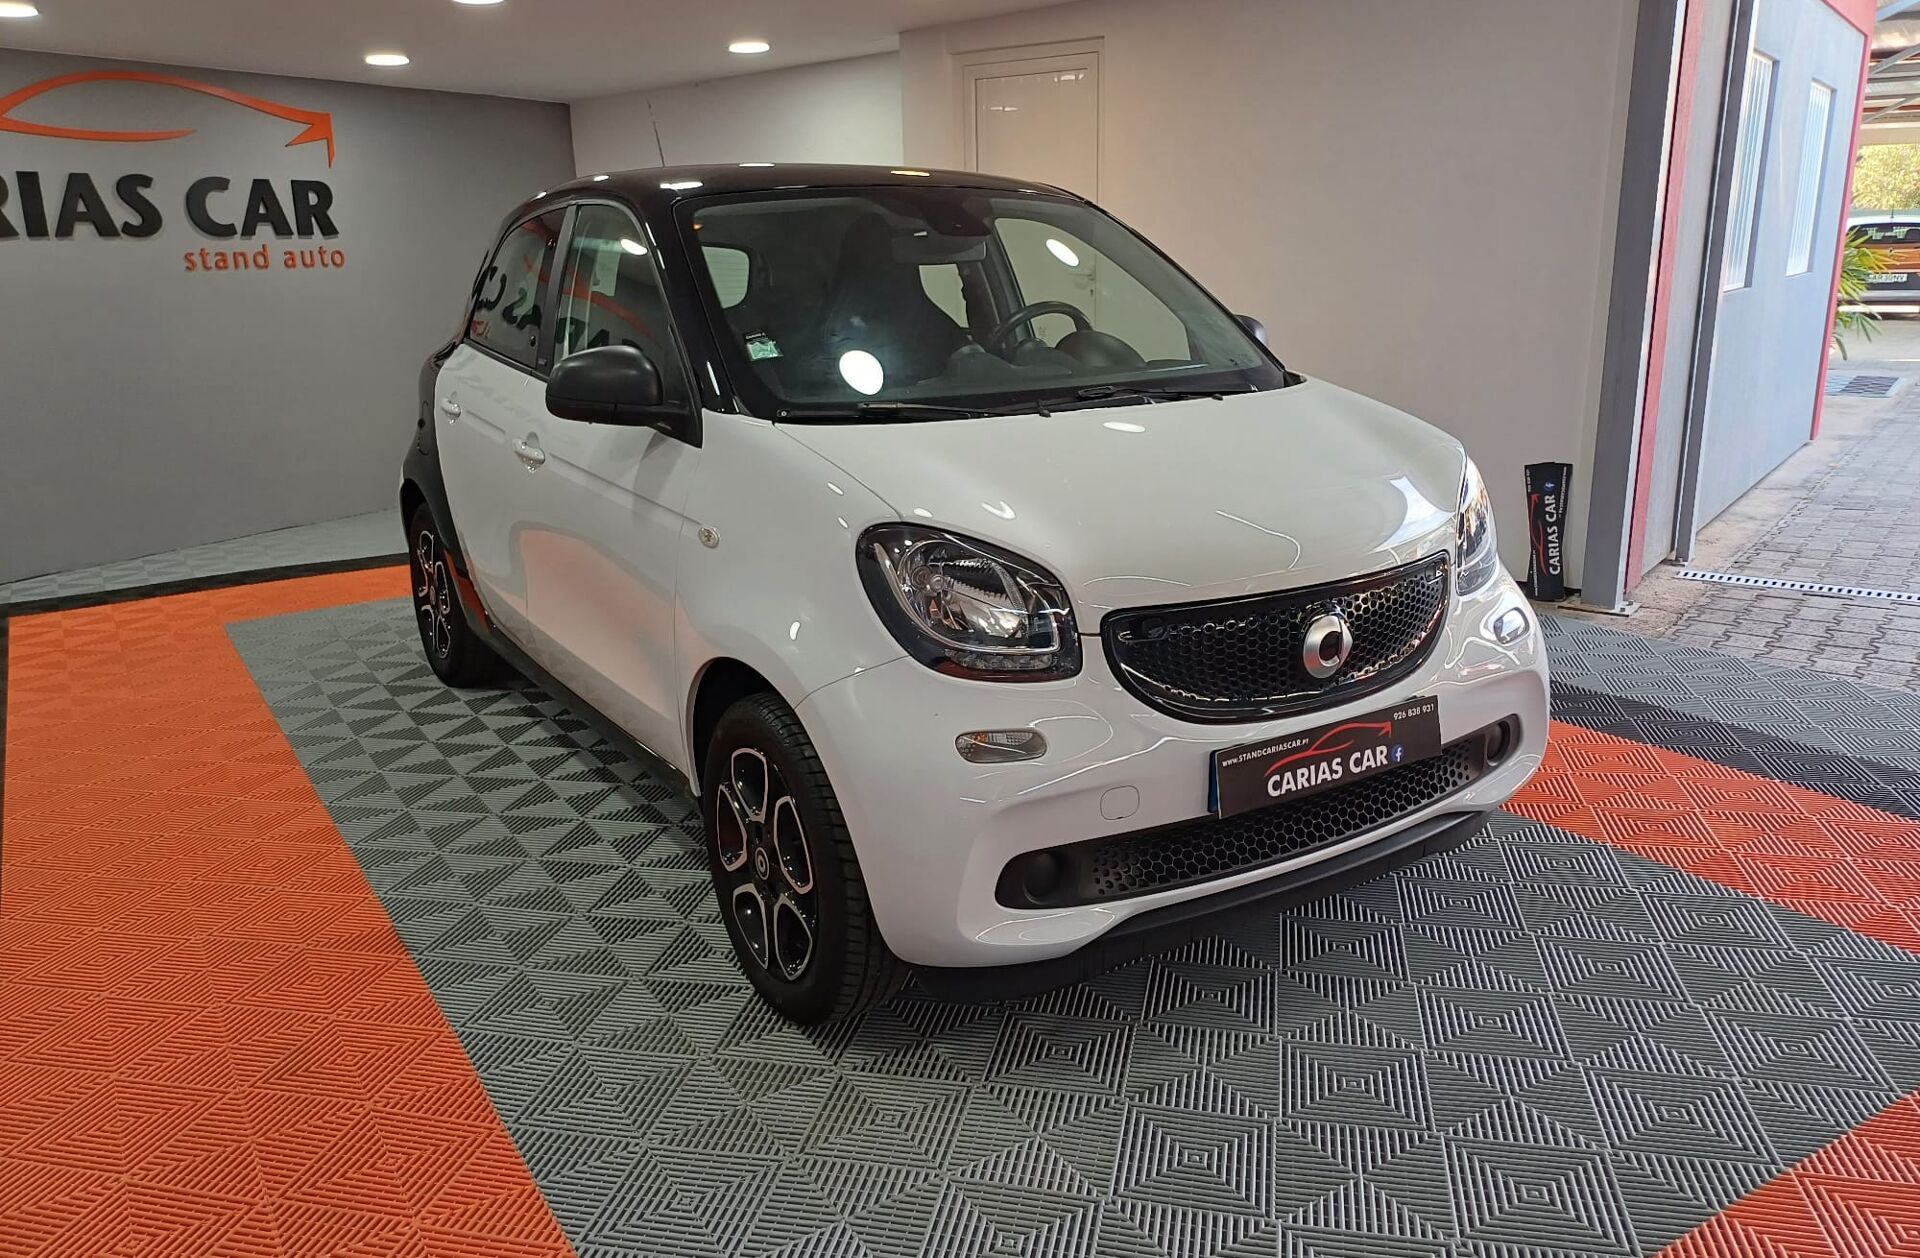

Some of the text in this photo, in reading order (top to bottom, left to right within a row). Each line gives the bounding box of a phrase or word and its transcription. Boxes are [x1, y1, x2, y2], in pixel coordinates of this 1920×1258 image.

[185, 176, 340, 238] CAR
[184, 244, 345, 272] stand auto
[1544, 494, 1557, 522] CAR
[1547, 525, 1561, 575] CARIAS
[1393, 711, 1407, 721] 926
[1422, 703, 1435, 715] 931
[1267, 757, 1343, 797] CARIAS
[1349, 745, 1388, 774] CAR
